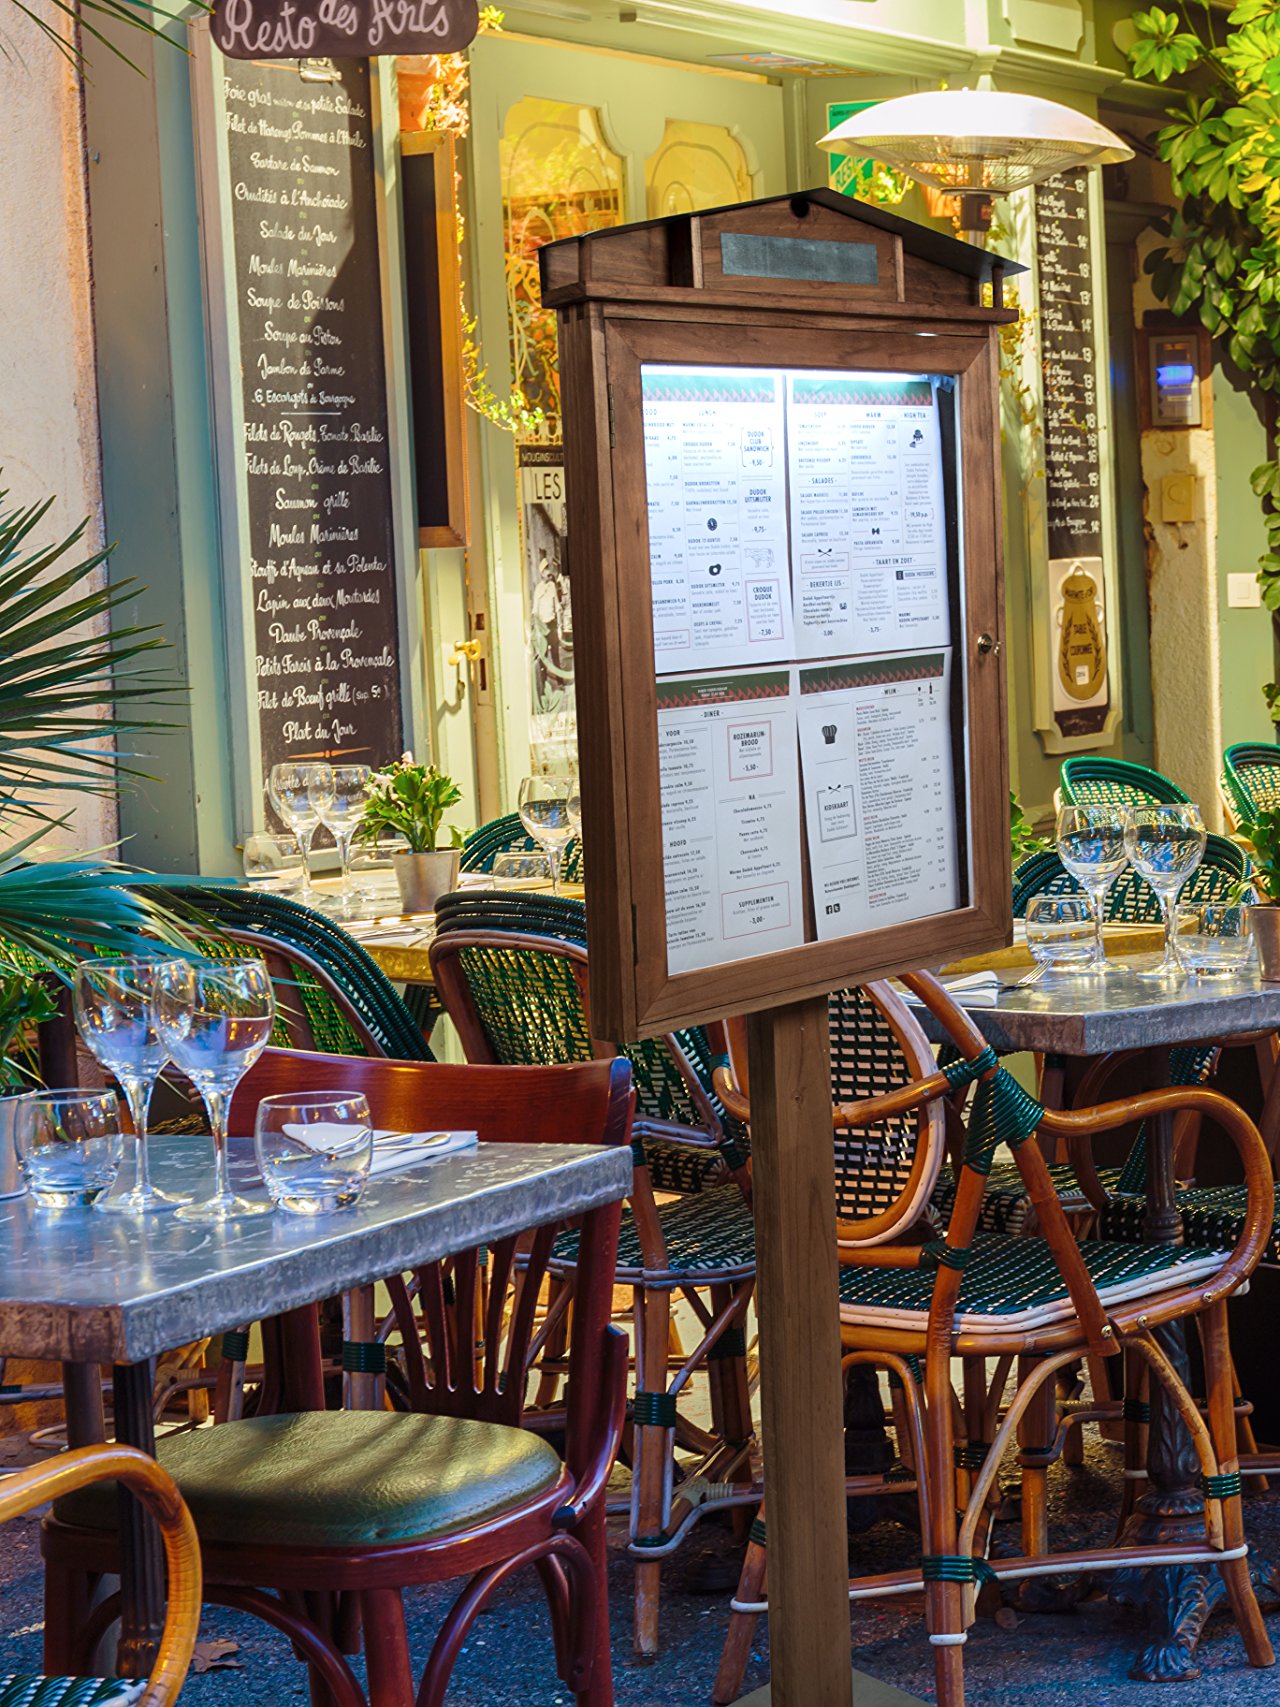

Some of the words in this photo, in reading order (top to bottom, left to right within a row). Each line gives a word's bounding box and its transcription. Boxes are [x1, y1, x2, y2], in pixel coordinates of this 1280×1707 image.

[221, 0, 317, 51] Resto
[319, 0, 358, 34] des
[368, 0, 450, 46] Arts
[248, 89, 272, 108] gras
[290, 159, 302, 171] de
[260, 220, 295, 240] Salade
[298, 226, 312, 241] du
[312, 225, 337, 247] Jour
[247, 287, 283, 314] Soupe
[287, 293, 301, 310] de
[301, 290, 345, 312] Poissons
[264, 321, 297, 348] Soupe
[299, 333, 313, 344] au
[257, 353, 297, 380] Jambon
[299, 361, 312, 376] de
[254, 389, 263, 403] 6
[266, 389, 308, 409] Escargots
[269, 425, 281, 441] de
[270, 461, 281, 475] de
[337, 460, 348, 474] de
[535, 473, 561, 500] LES
[275, 487, 318, 510] Saumon
[268, 523, 305, 548] Moules
[347, 554, 387, 574] Polenta
[257, 588, 291, 618] Lapin
[268, 622, 307, 644] Daube
[314, 656, 324, 672] à
[326, 652, 339, 671] la
[281, 692, 294, 708] de
[282, 721, 312, 743] Plat
[314, 723, 330, 739] du
[331, 718, 357, 744] Jour
[741, 739, 758, 747] BROOD
